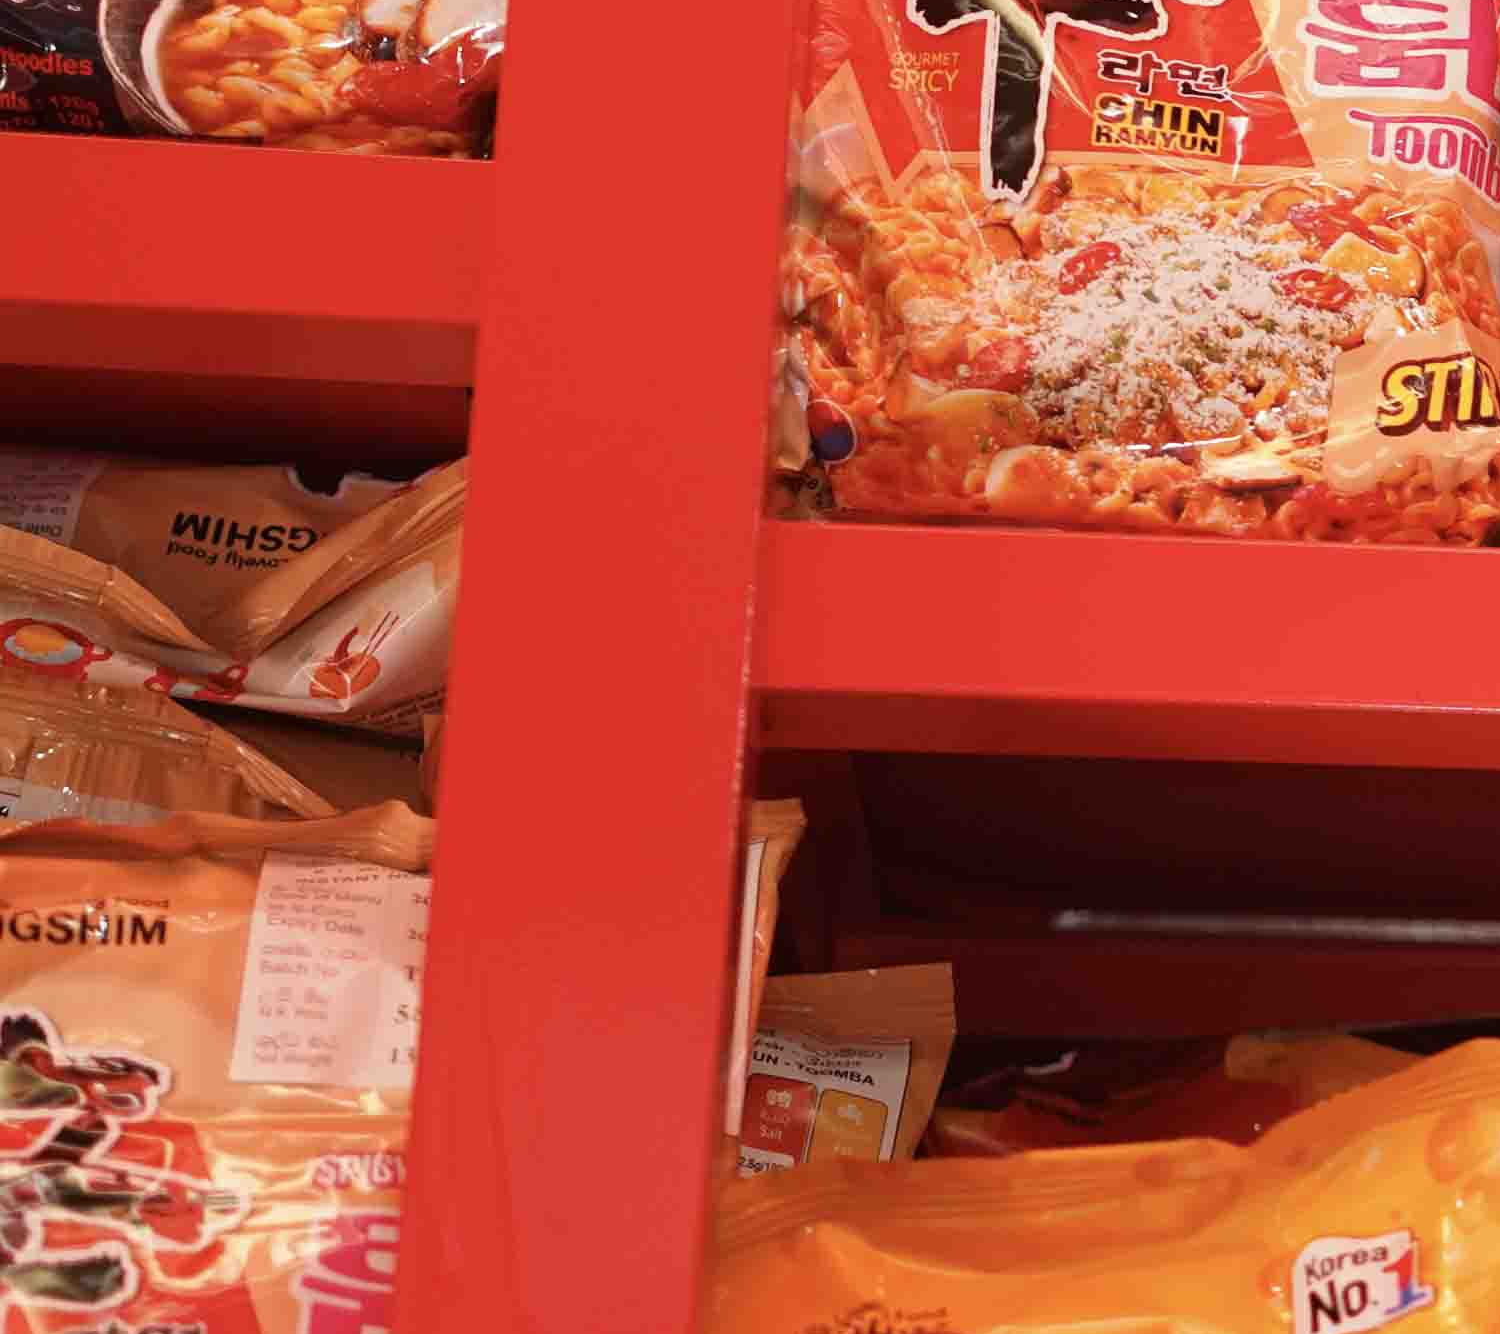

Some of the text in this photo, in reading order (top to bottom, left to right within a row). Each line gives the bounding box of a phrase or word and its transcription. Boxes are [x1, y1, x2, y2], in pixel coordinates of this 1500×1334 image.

[887, 69, 959, 93] SPICY
[1096, 47, 1232, 101] 라면
[1094, 92, 1224, 137] SHIN
[1093, 124, 1223, 156] RAMYUN
[1302, 1245, 1391, 1287] Korea
